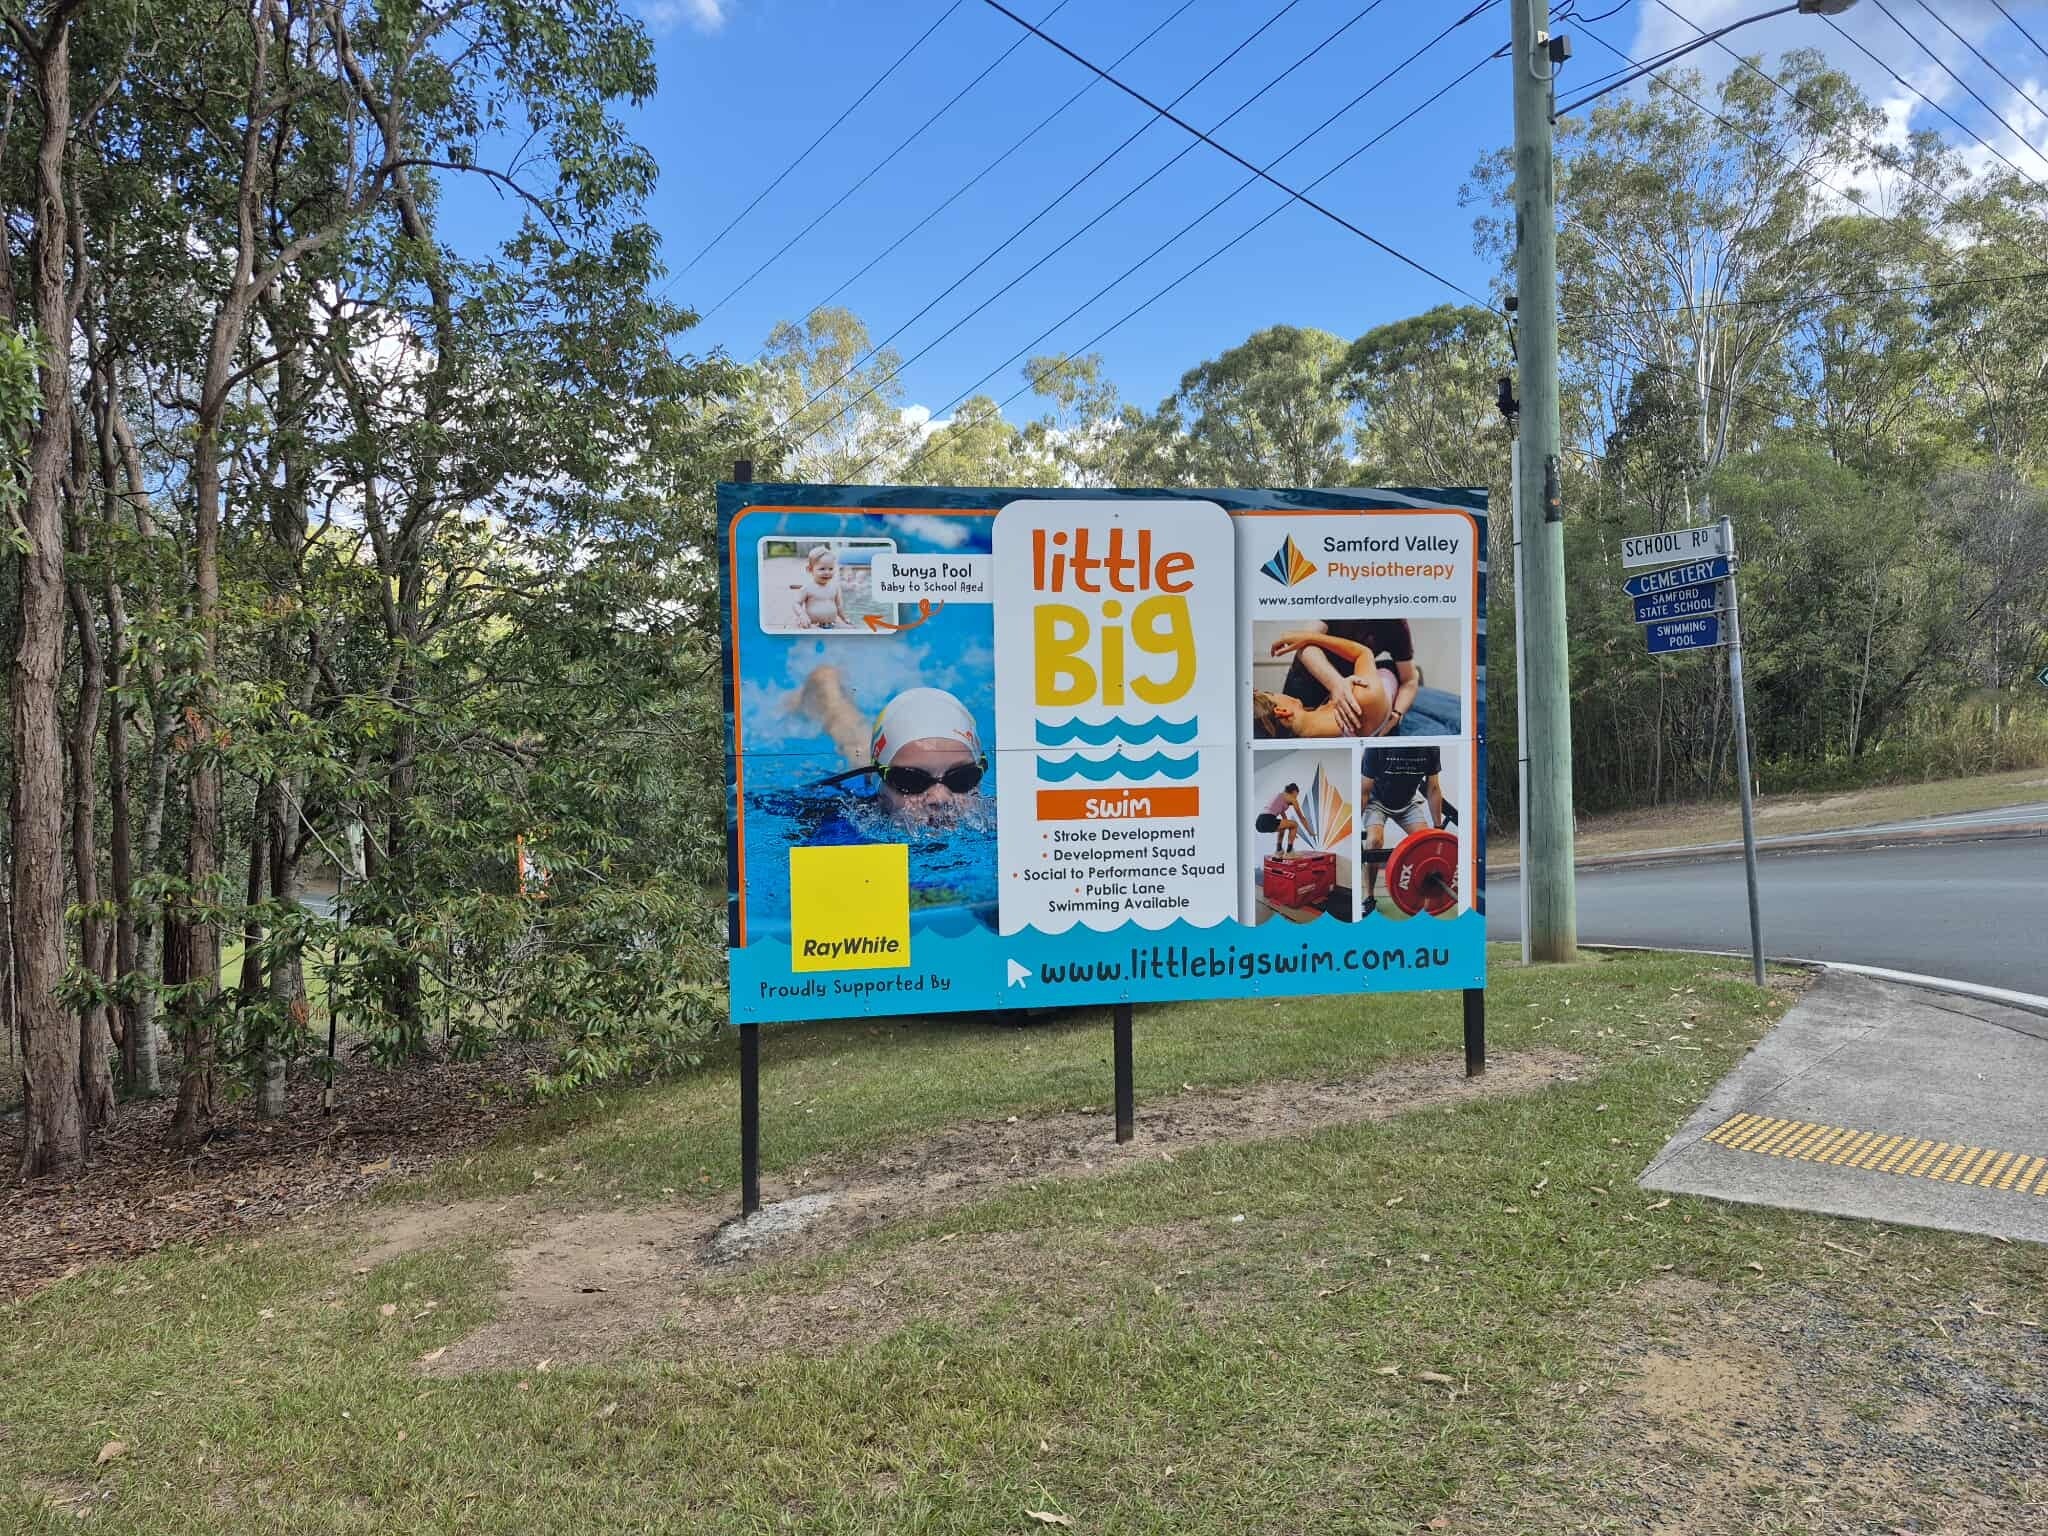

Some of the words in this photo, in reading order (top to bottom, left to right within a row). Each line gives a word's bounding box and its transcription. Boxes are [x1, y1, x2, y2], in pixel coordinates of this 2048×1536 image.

[1323, 536, 1399, 553] Samford
[1405, 536, 1459, 555] Valley
[1626, 534, 1681, 557] SCHOOL
[1692, 530, 1708, 548] RD
[1032, 528, 1195, 593] little
[892, 563, 937, 579] Bunya
[942, 563, 972, 578] Pool
[1328, 562, 1455, 580] Physiotherapy
[1640, 560, 1714, 592] CEMETERY
[881, 581, 905, 592] Baby
[909, 581, 920, 592] to
[924, 581, 957, 592] School
[960, 581, 984, 592] Aged
[1259, 594, 1457, 607] www.samfordvalleyphysio.com.au
[1652, 588, 1699, 605] SAMFORD
[1640, 606, 1669, 619] STATE
[1674, 598, 1713, 613] SCHOOL
[1657, 621, 1706, 637] SWIMMING
[1669, 635, 1697, 647] POOL
[1033, 594, 1197, 706] Big
[1054, 830, 1097, 842] Stroke
[1102, 827, 1195, 842] Development
[1054, 848, 1148, 862] Development
[1152, 845, 1196, 860] Squad
[1024, 868, 1067, 881] Social
[1071, 869, 1084, 880] to
[1088, 865, 1177, 879] Performance
[1181, 863, 1225, 877] Squad
[1086, 883, 1128, 896] Public
[1132, 882, 1165, 894] Lane
[1048, 899, 1120, 913] Swimming
[1124, 896, 1190, 910] Available
[1041, 944, 1450, 984] www.littlebigswim.com.au
[760, 980, 826, 999] Proudly
[833, 975, 924, 997] Supported
[930, 975, 951, 991] By
